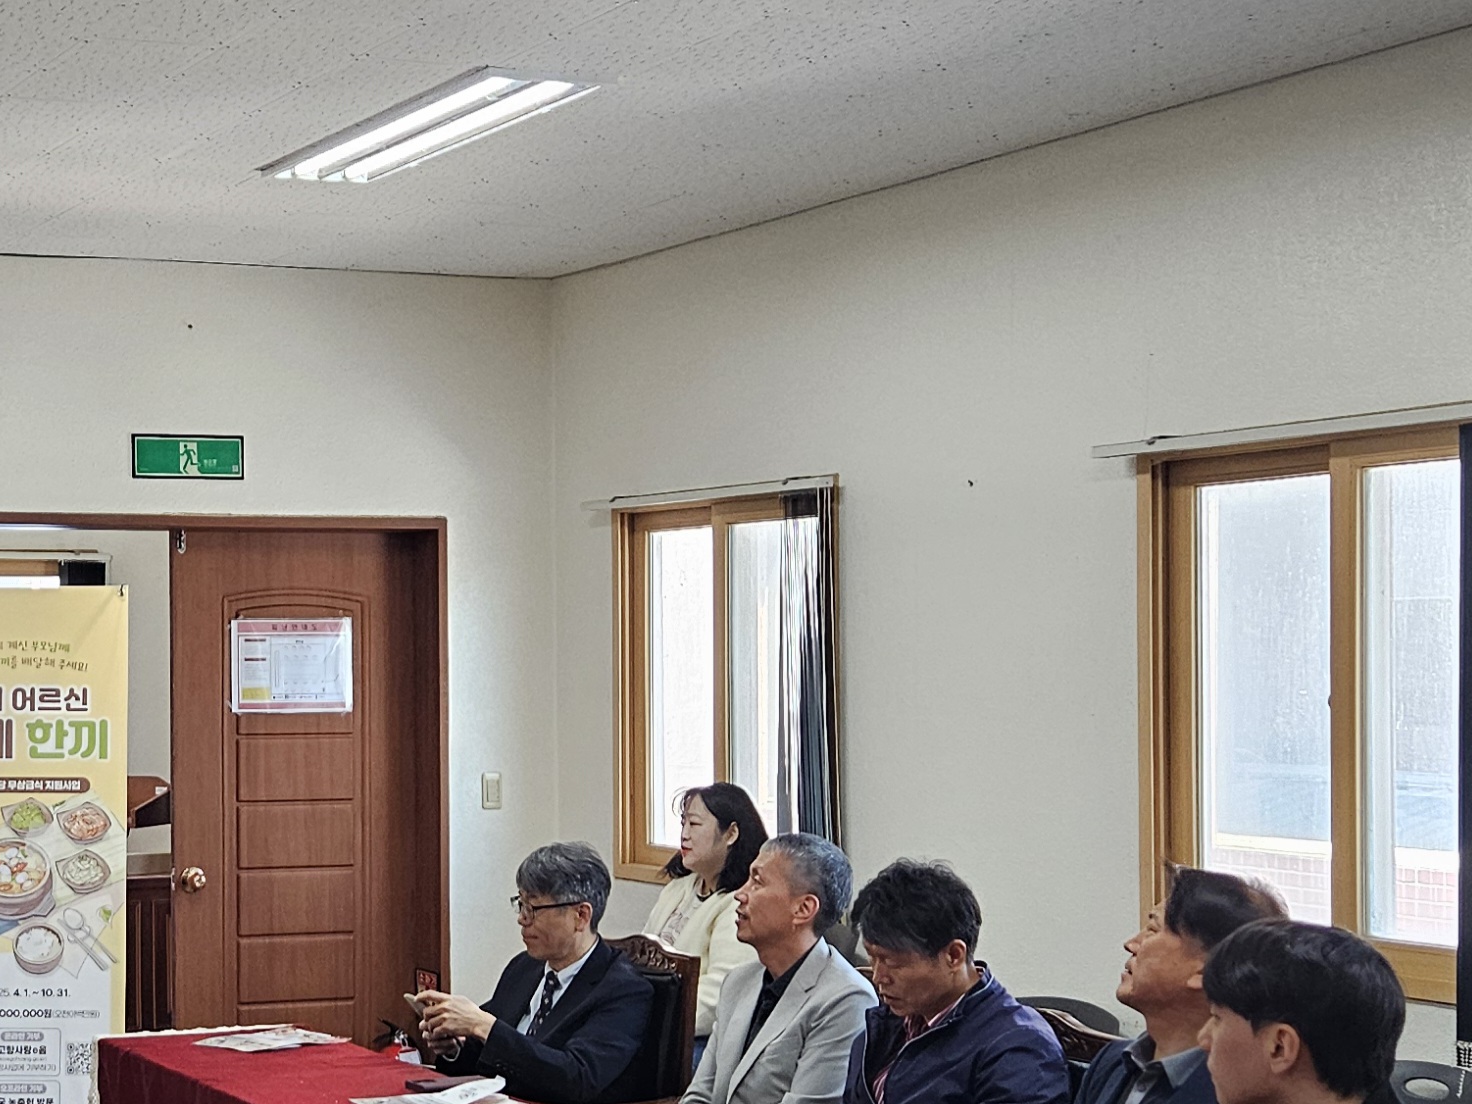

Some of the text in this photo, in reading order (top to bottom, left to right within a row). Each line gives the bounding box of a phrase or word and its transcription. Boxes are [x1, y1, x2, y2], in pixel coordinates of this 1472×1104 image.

[8, 641, 28, 651] 계신
[32, 641, 71, 653] 부모님께
[21, 656, 55, 669] 배달해
[58, 658, 88, 672] 주세요!
[12, 686, 88, 712] 어르신
[26, 718, 108, 760] 한끼
